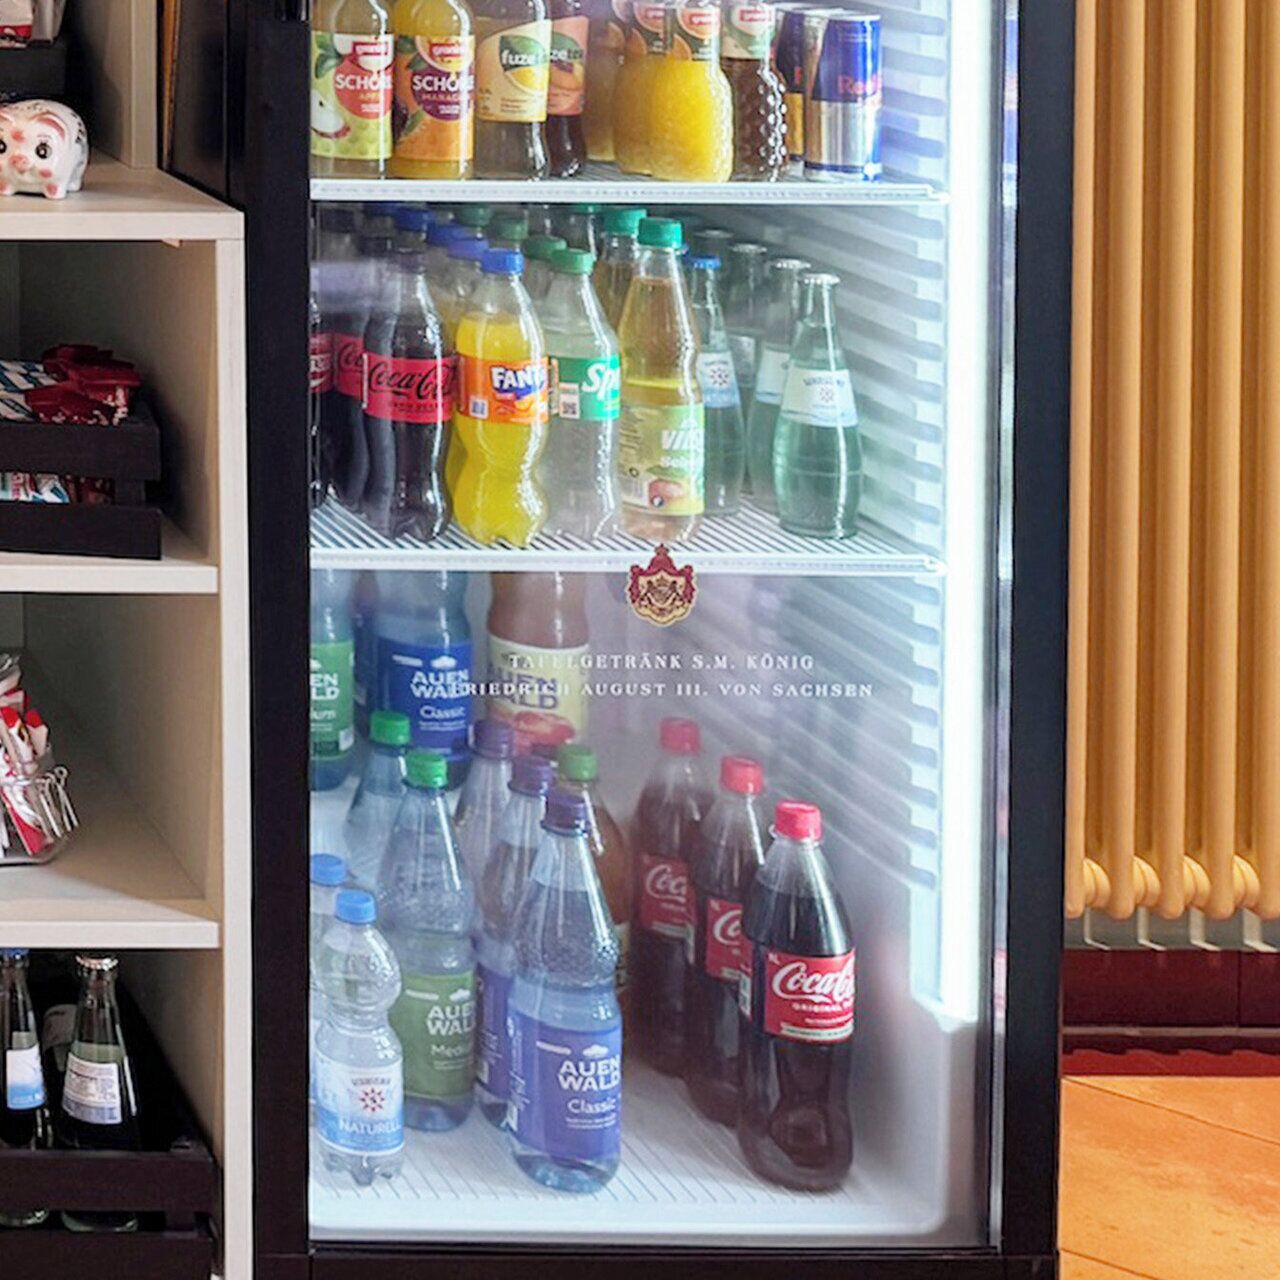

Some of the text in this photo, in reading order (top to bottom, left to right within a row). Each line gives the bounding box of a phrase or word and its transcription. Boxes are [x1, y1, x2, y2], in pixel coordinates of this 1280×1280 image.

[691, 655, 736, 670] S.M.
[746, 652, 815, 671] KÖNIG
[582, 683, 666, 697] AUGUST
[676, 683, 709, 697] III.
[719, 683, 762, 697] VON
[773, 683, 873, 698] SACHSEN
[559, 1055, 620, 1076] AUEN
[557, 1071, 620, 1091] WALD
[566, 1097, 617, 1114] Classic
